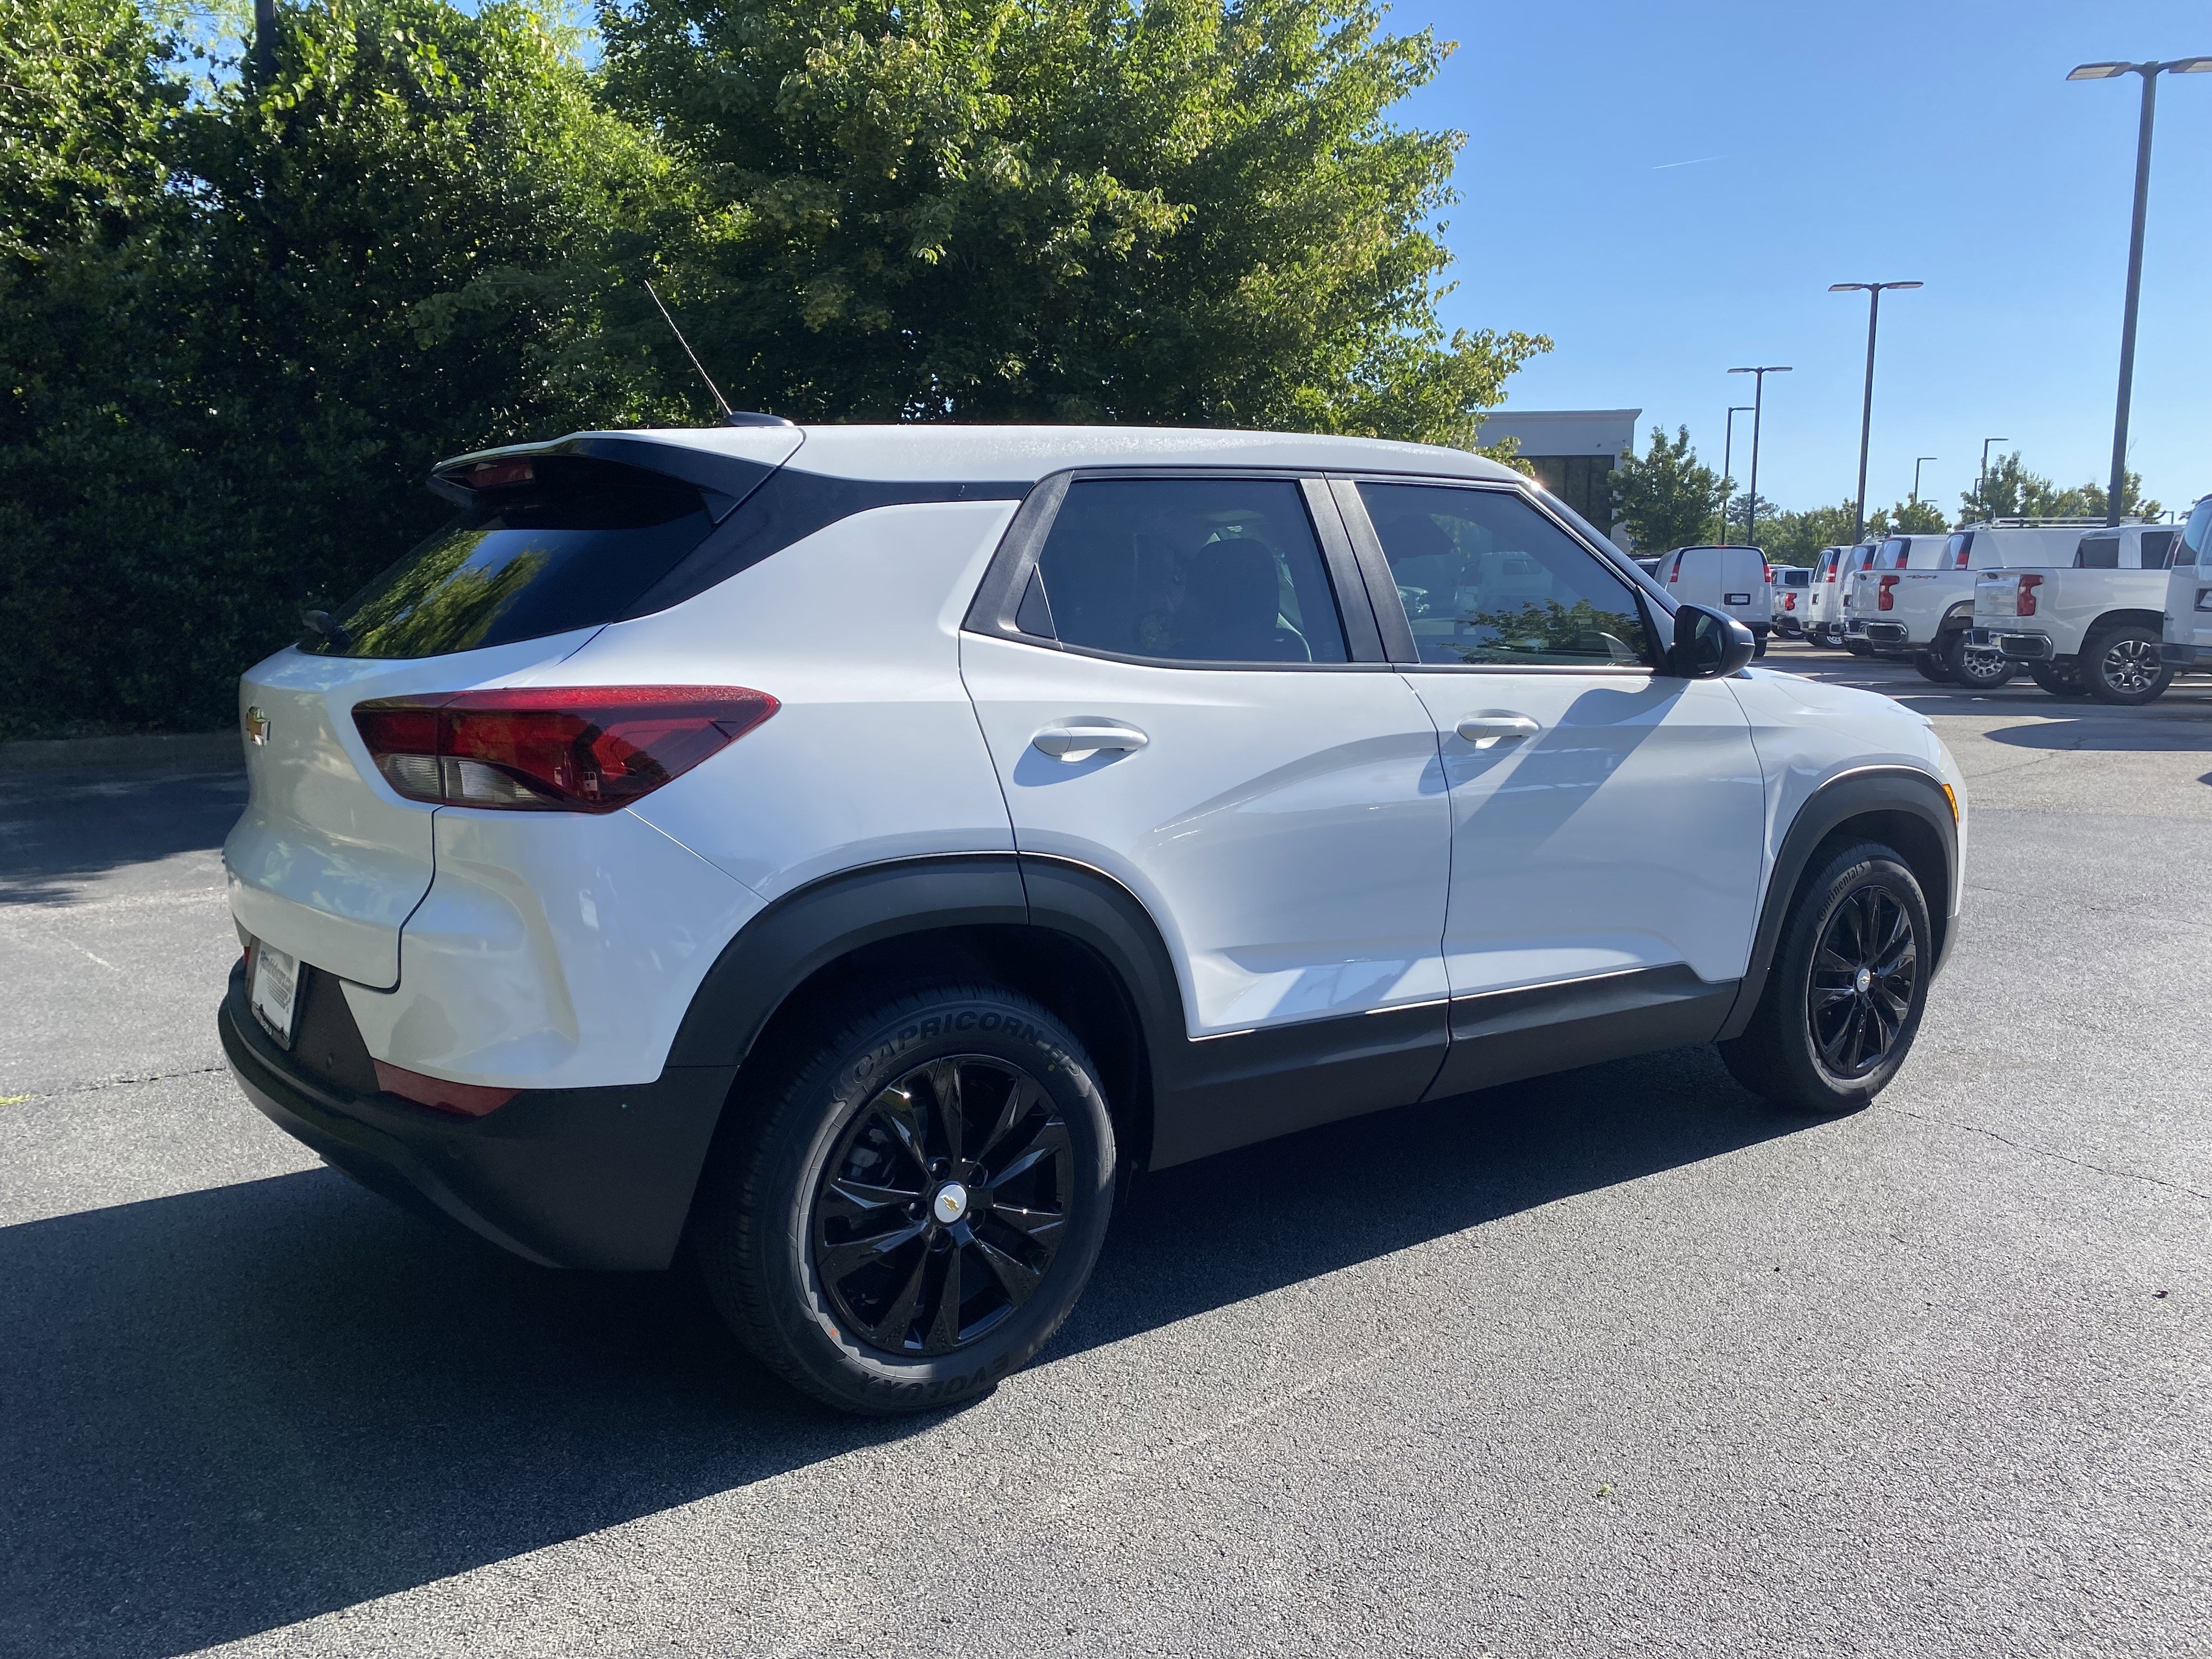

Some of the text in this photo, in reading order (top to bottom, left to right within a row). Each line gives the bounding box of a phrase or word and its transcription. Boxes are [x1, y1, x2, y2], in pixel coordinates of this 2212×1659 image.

[1817, 865, 1859, 922] Continental
[851, 1010, 1080, 1084] CAPRICORN HP
